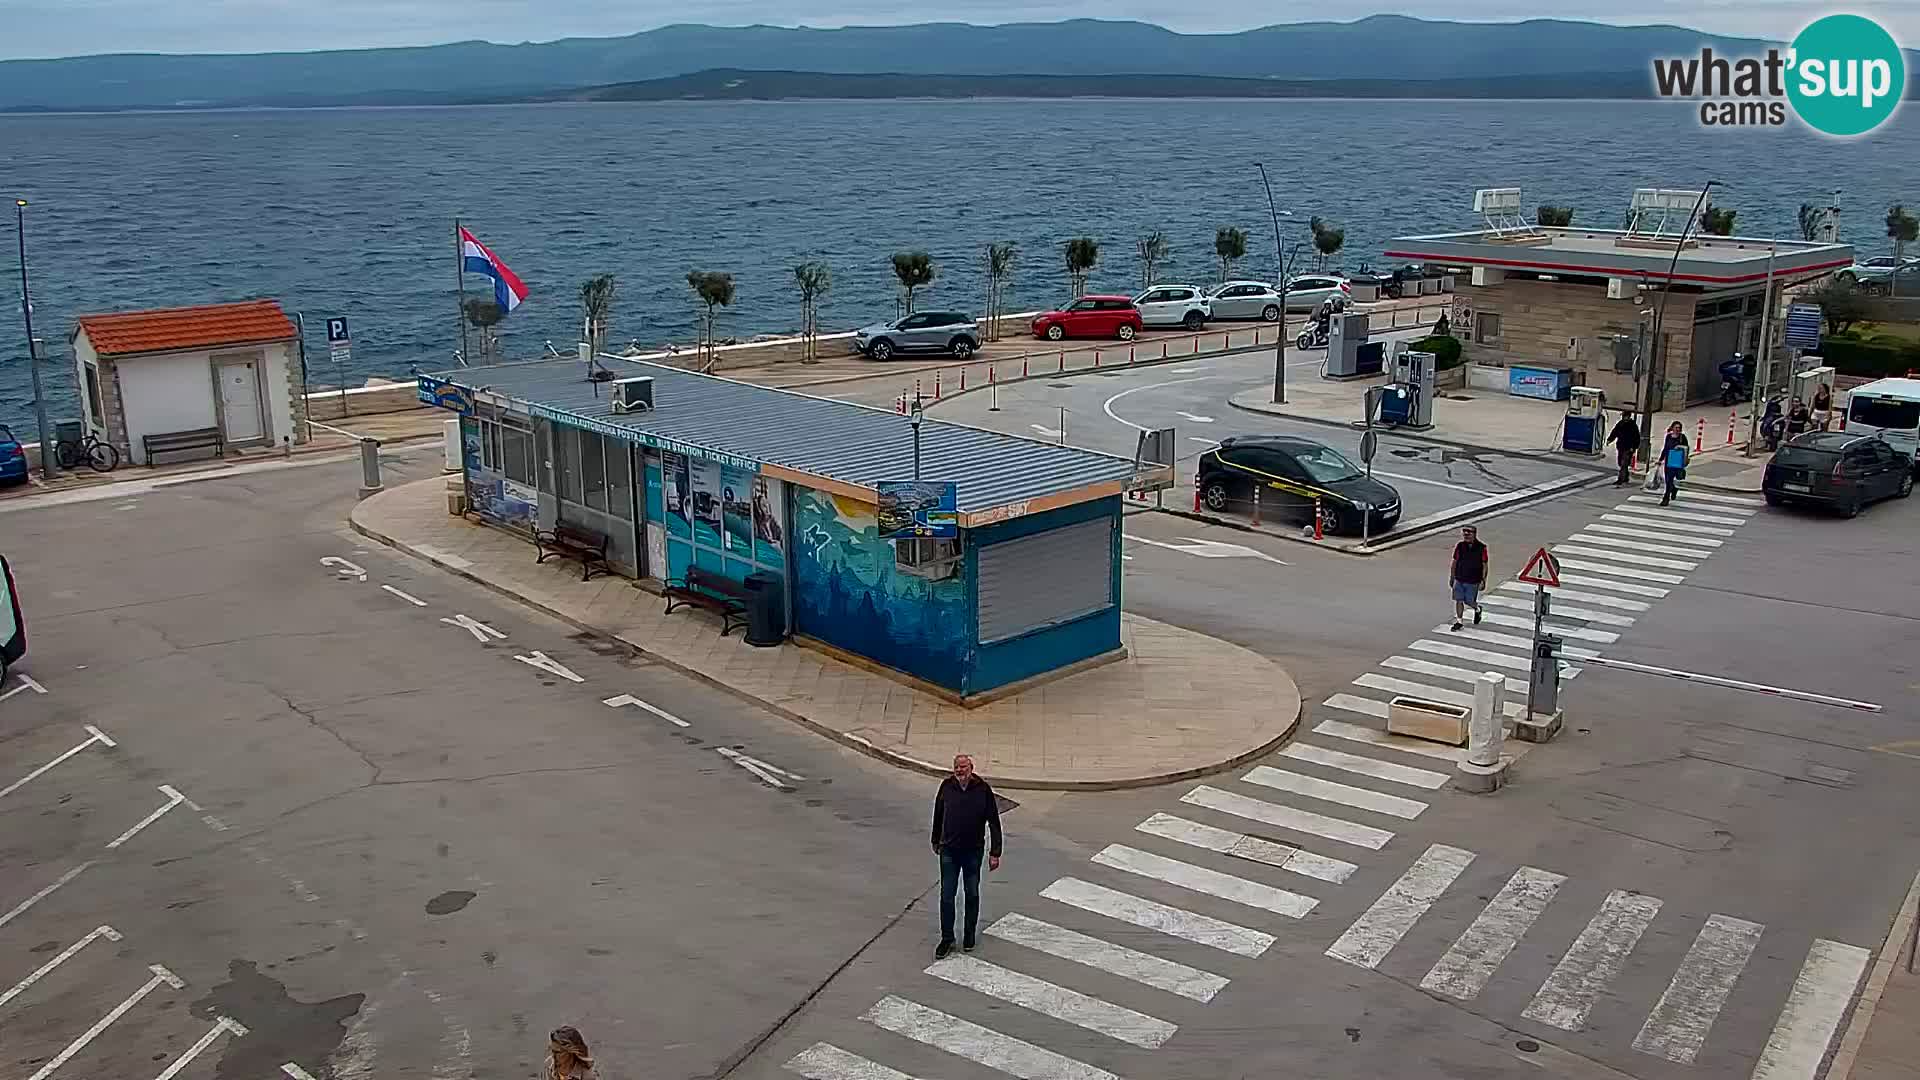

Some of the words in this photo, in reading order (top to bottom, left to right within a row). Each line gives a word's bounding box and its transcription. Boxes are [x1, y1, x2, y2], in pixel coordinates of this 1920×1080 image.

[331, 320, 343, 338] P
[617, 428, 647, 444] POSTAJA
[656, 438, 671, 450] BUS
[672, 443, 703, 458] STATION
[704, 450, 729, 465] TICKET
[731, 457, 757, 471] OFFICE
